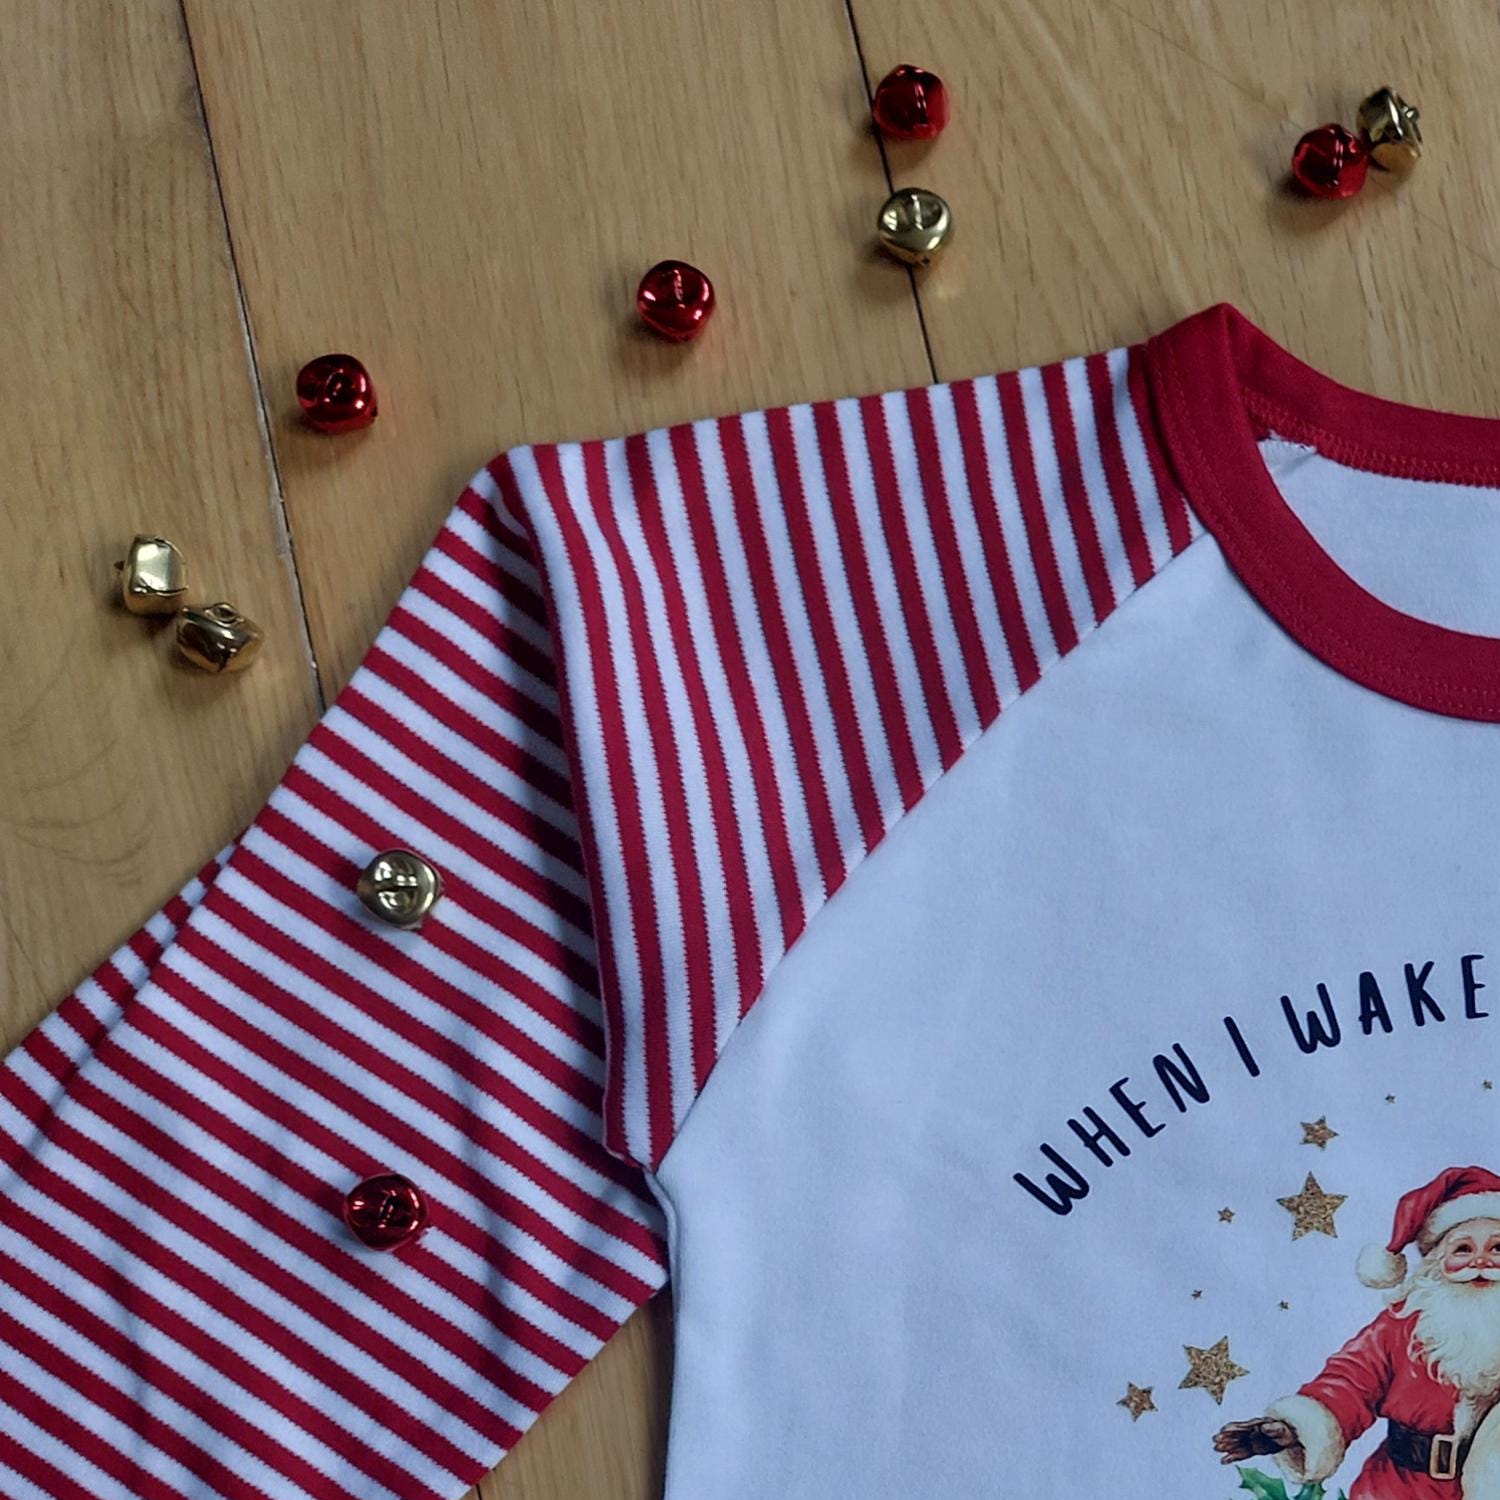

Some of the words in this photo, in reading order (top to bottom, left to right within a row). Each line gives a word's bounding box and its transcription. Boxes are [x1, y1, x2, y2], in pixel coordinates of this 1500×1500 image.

[1012, 1043, 1210, 1216] WHEN
[1223, 1015, 1261, 1078] I
[1280, 954, 1489, 1054] WAKE
